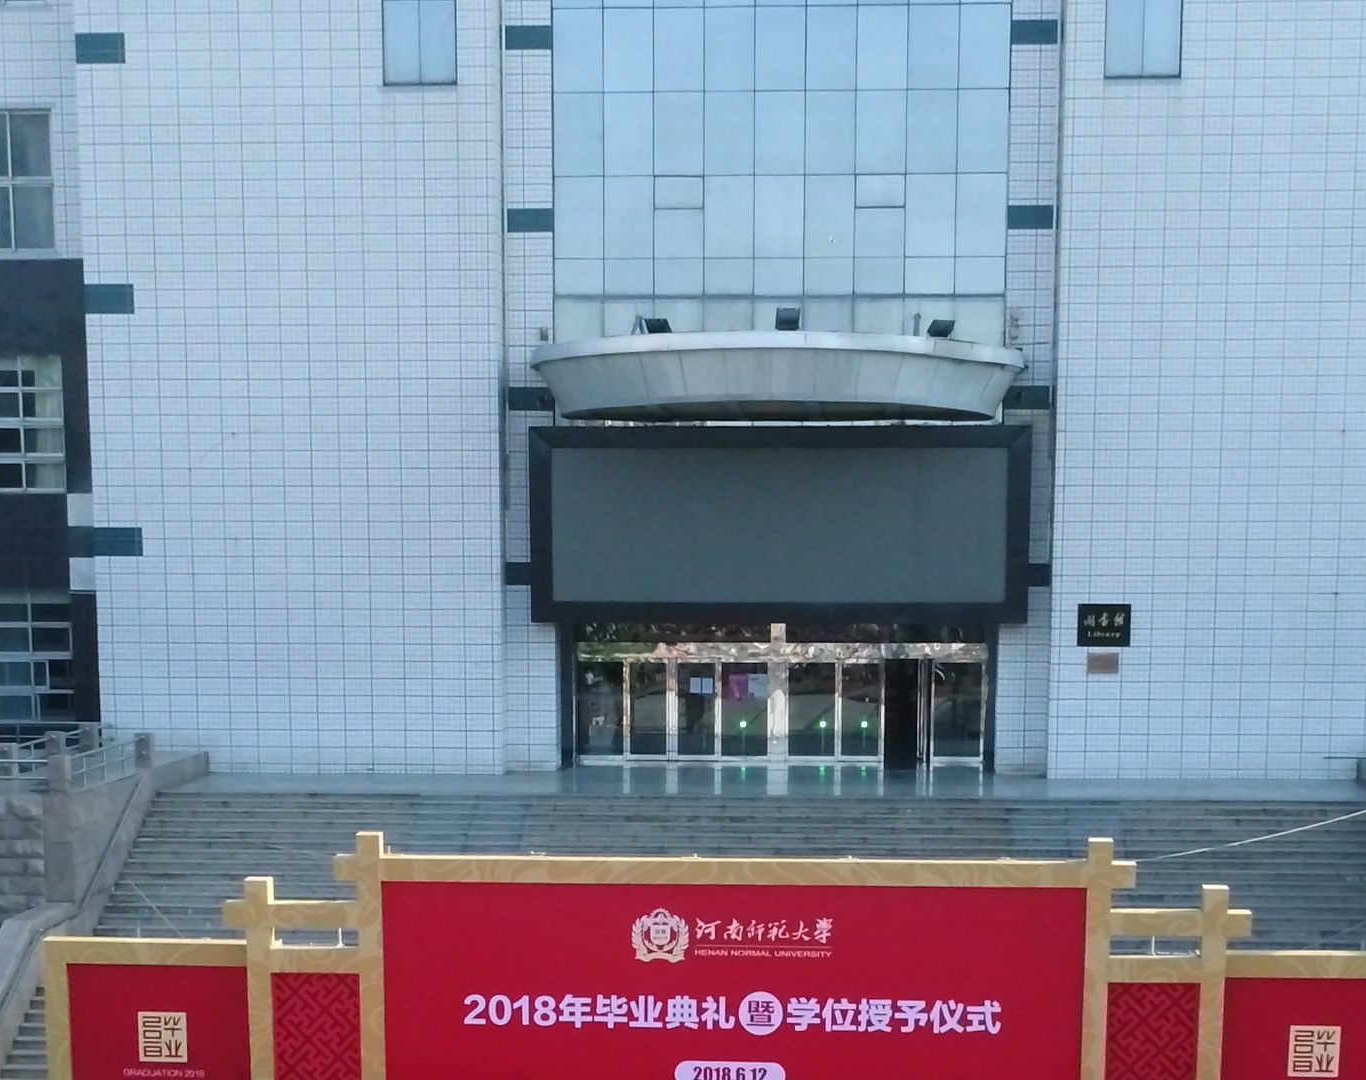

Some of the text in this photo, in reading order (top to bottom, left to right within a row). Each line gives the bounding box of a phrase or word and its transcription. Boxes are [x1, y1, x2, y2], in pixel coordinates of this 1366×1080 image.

[694, 949, 833, 958] HENAN NORMAL UNIVERSITY
[463, 994, 1002, 1034] 2018年毕业典礼暨学位授予仪式
[123, 1068, 205, 1078] GRADUATION 2018
